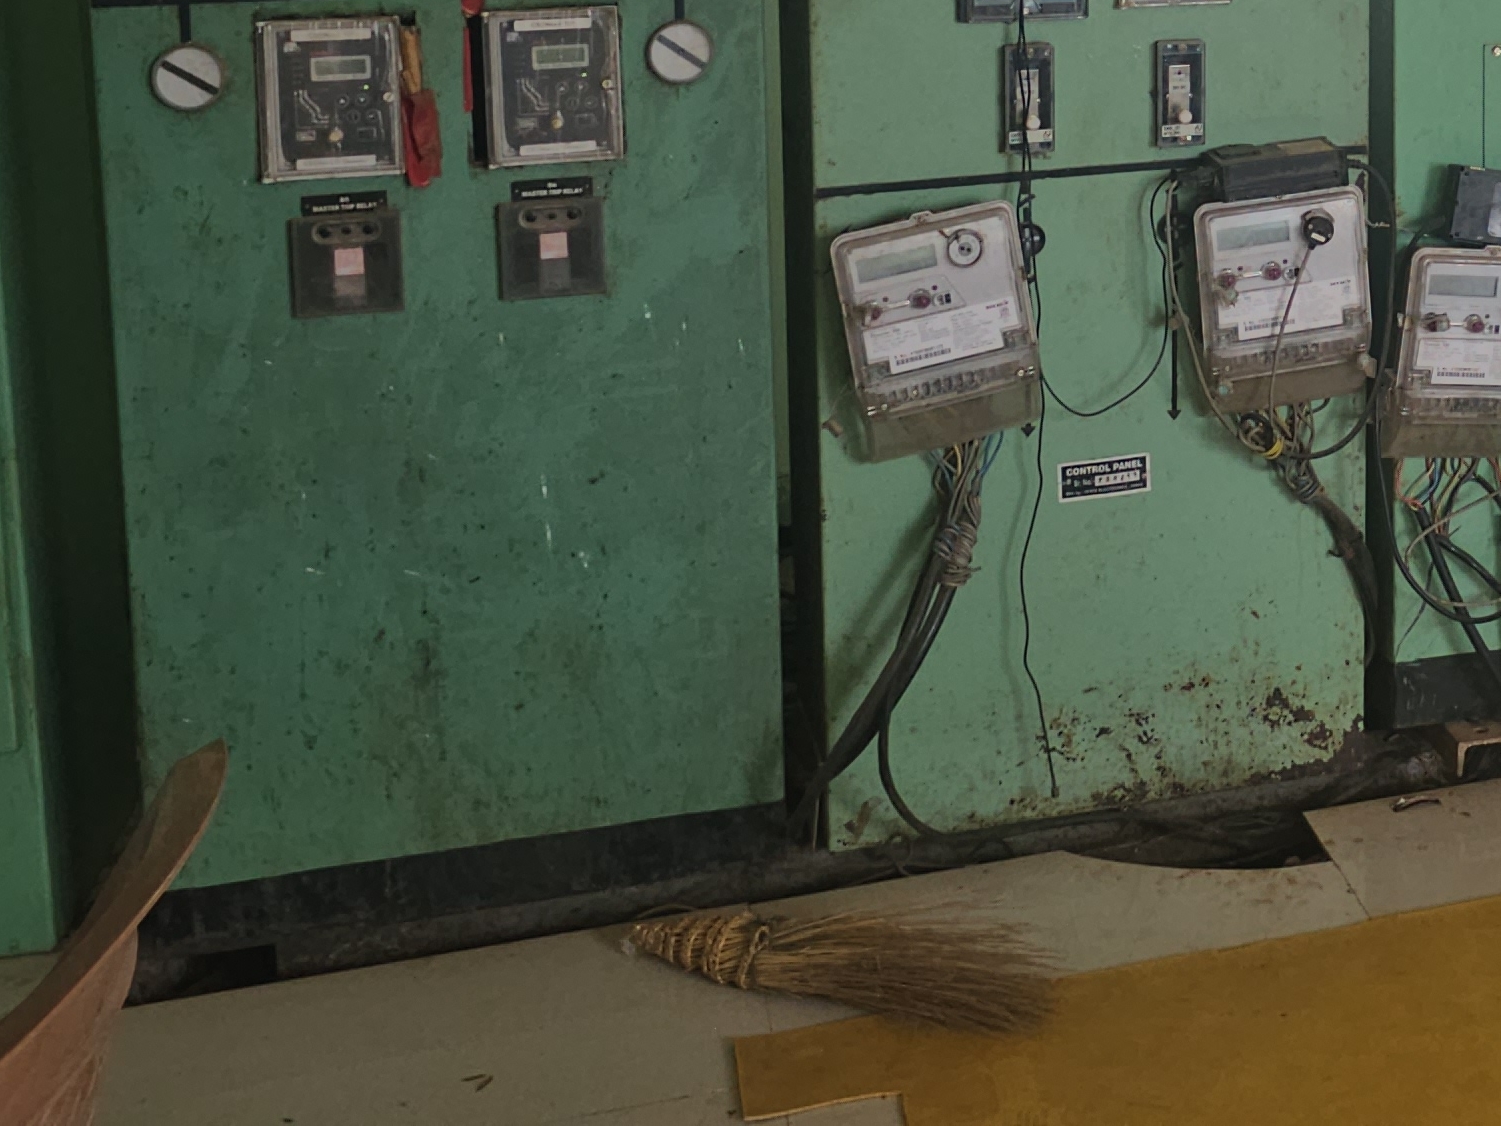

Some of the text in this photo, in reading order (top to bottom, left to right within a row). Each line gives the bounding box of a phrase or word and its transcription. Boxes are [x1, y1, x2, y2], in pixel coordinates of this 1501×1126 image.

[521, 189, 547, 197] MASTER
[548, 188, 562, 196] TRIP
[312, 202, 377, 213] MASTER TRIP RELAY
[1065, 459, 1143, 477] CONTROL PANEL
